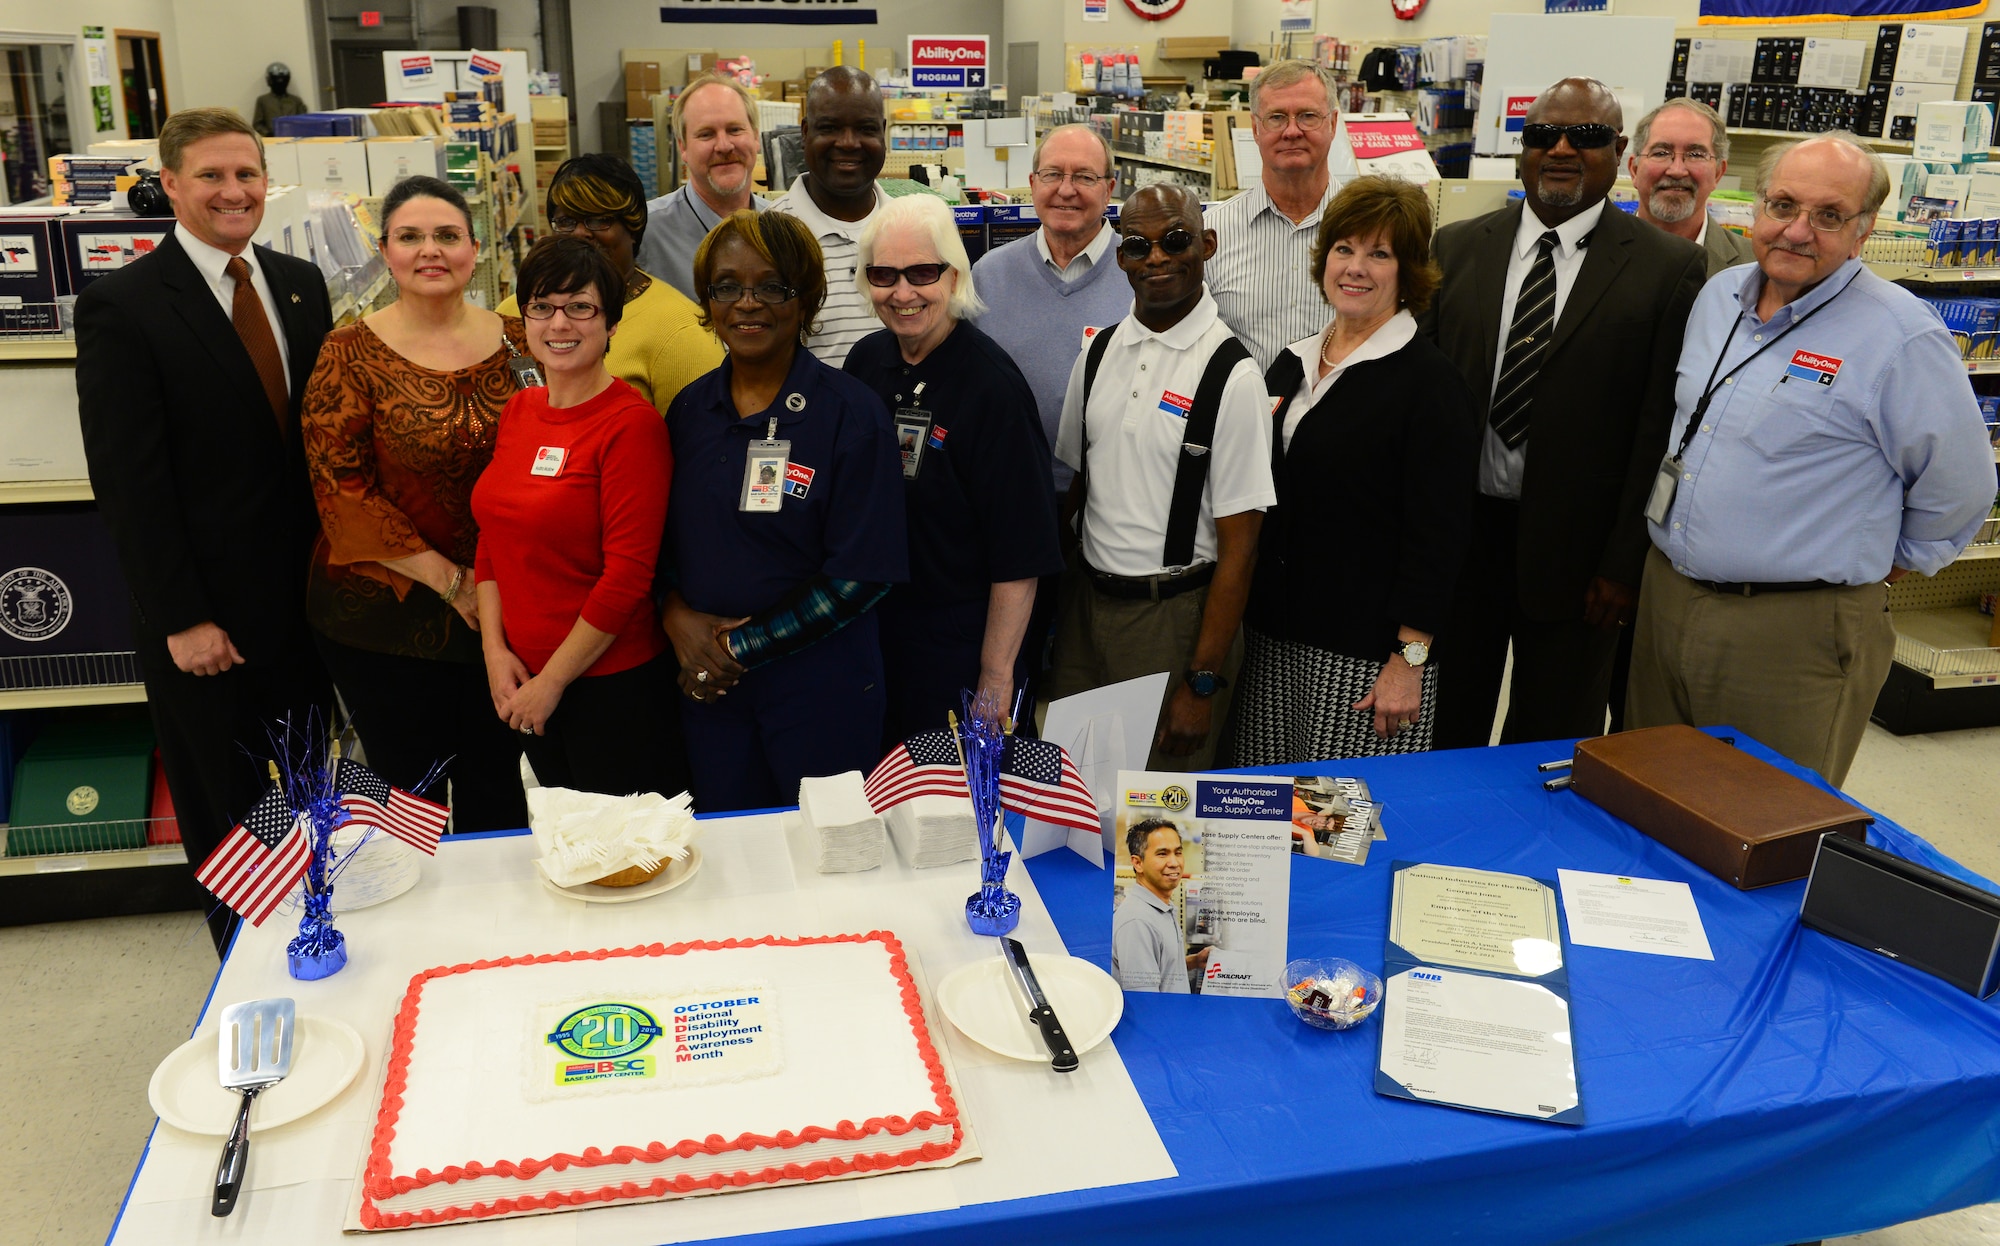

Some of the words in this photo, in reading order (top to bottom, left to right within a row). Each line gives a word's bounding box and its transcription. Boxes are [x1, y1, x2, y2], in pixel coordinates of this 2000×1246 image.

[917, 46, 982, 62] AbilityOne
[1796, 354, 1838, 369] AbilityOne
[49, 580, 61, 590] AIR
[1169, 790, 1181, 804] 20
[1232, 788, 1278, 796] Authorized
[1221, 797, 1265, 806] AbilityOne
[1202, 805, 1222, 813] Base
[1224, 806, 1252, 815] Supply
[1254, 806, 1284, 815] Center
[1333, 800, 1373, 861] OPPORTUNITY
[1445, 877, 1486, 885] Industries
[1431, 904, 1471, 912] Employee
[1413, 972, 1442, 980] NIB
[674, 997, 759, 1013] OCTOBER
[675, 1009, 732, 1023] National
[581, 1014, 631, 1049] 20
[675, 1019, 739, 1032] Disability
[675, 1025, 762, 1042] Employment
[675, 1037, 753, 1052] Awareness
[676, 1050, 723, 1062] Month
[598, 1060, 645, 1073] BSC
